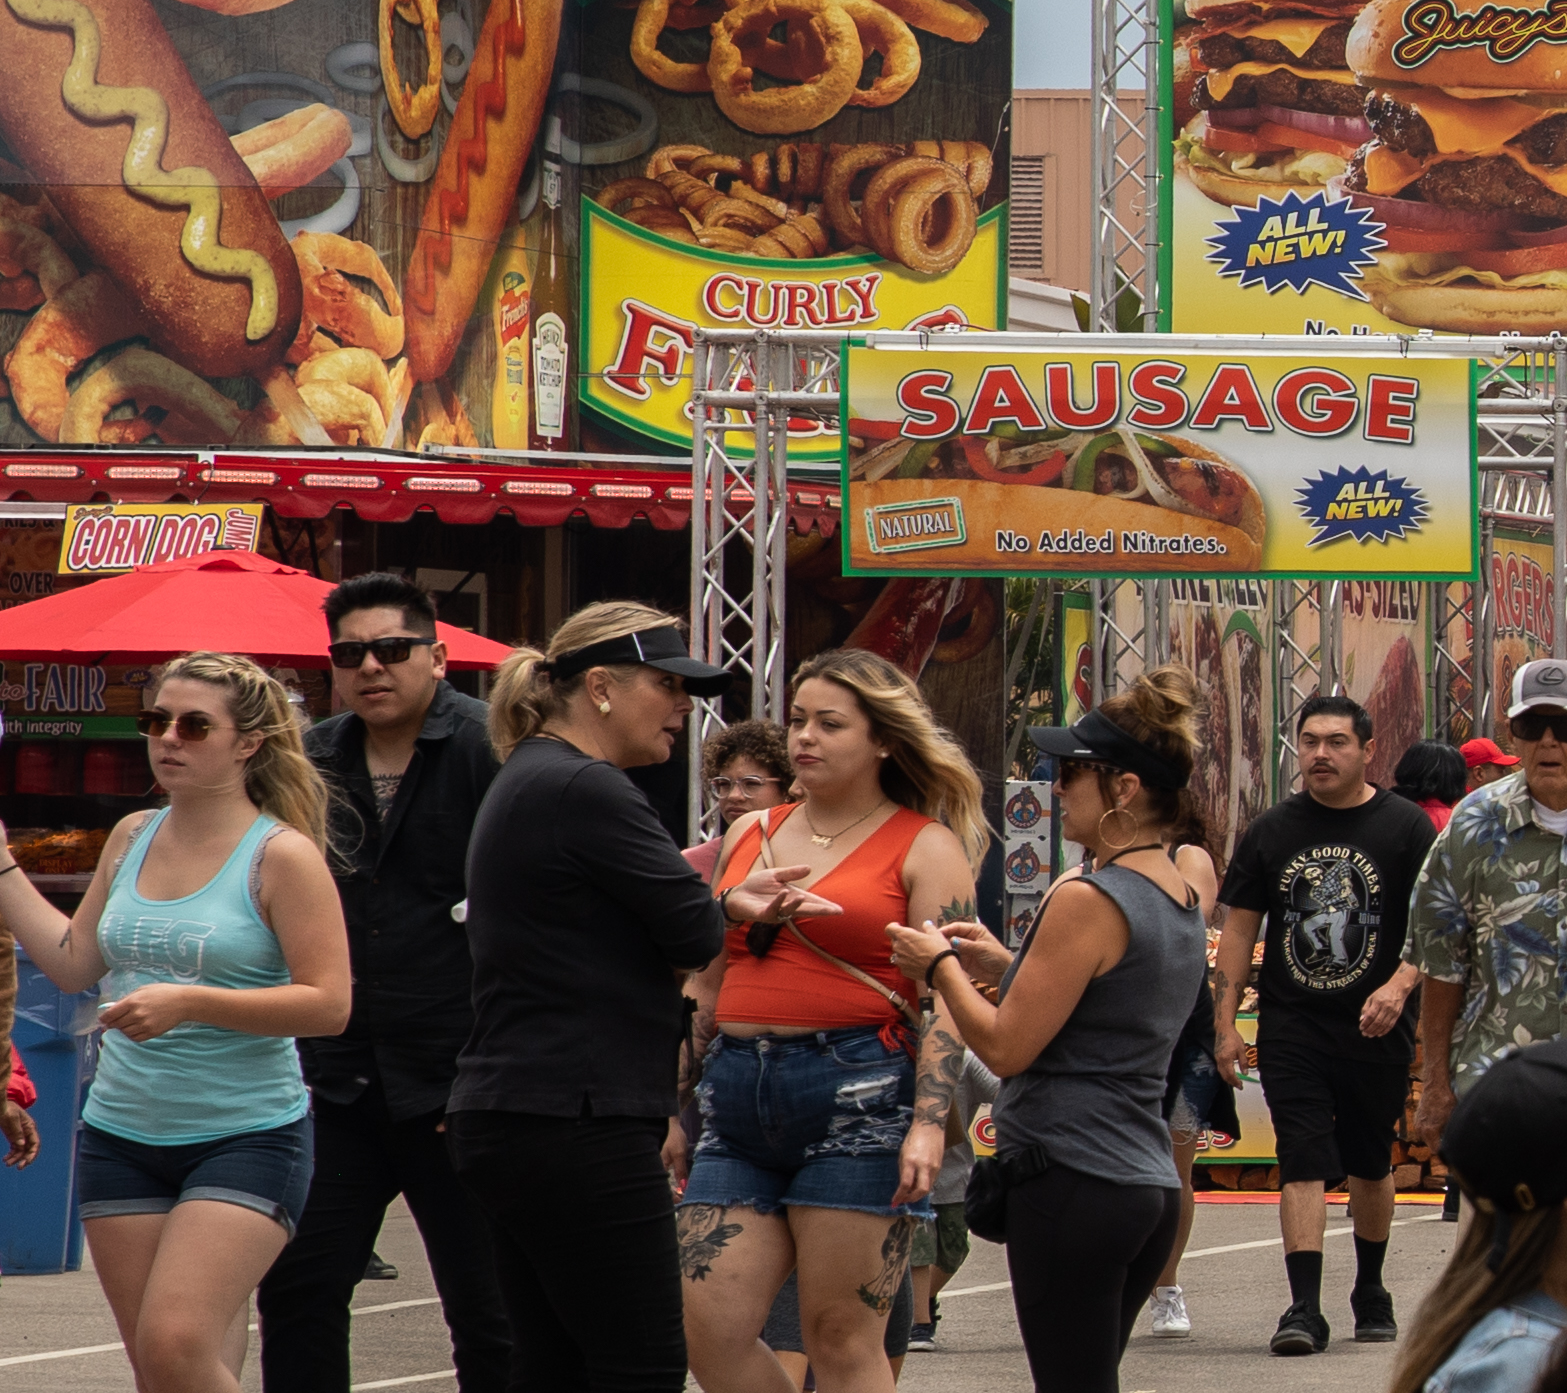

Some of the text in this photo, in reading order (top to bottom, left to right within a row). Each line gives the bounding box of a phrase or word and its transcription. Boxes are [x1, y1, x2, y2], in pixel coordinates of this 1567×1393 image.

[1257, 207, 1329, 240] ALL
[1246, 231, 1345, 268] NEW!
[703, 272, 882, 329] CURLY
[539, 371, 562, 388] KETCHUP
[895, 359, 1423, 445] SAUSAGE
[1334, 479, 1387, 503] ALL
[1325, 496, 1404, 522] NEW!
[67, 511, 222, 572] CORN DOG
[223, 508, 258, 553] JUMB
[878, 510, 956, 542] NATURAL
[996, 530, 1228, 555] No Added Nitrates.
[9, 571, 54, 595] OVER
[23, 662, 107, 713] FAIR
[0, 718, 83, 737] ith integrity
[38, 859, 73, 869] DISPLAY
[1279, 846, 1381, 895] FUNKY GOOD TIMES
[1326, 968, 1362, 989] STREETS
[1366, 931, 1377, 959] SOCAL
